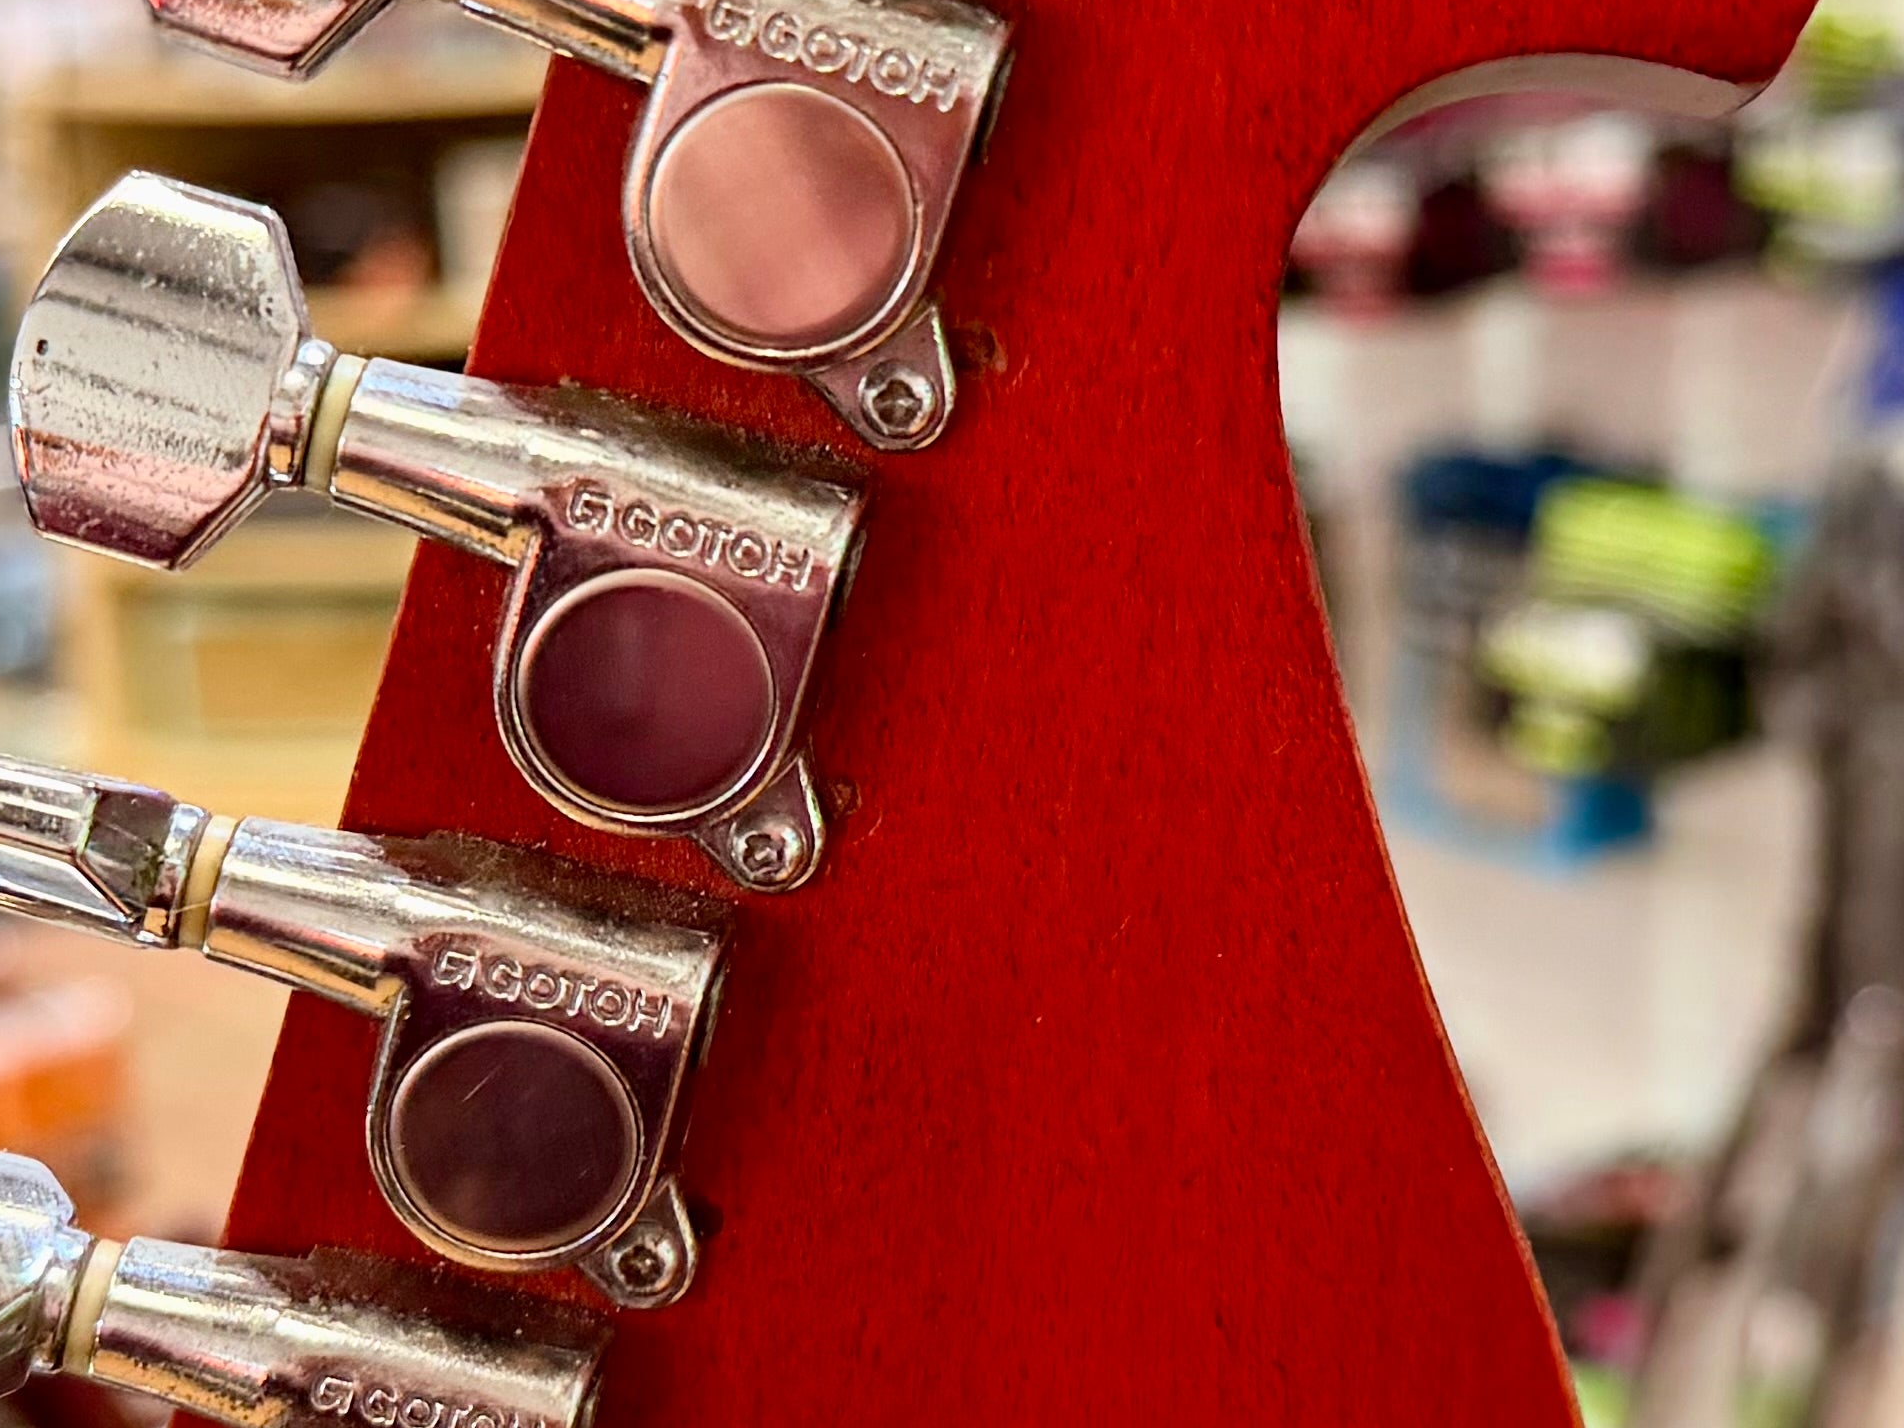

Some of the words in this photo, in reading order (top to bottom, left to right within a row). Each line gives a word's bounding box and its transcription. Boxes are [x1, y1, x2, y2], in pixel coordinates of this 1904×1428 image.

[759, 10, 960, 114] GOTOH
[619, 500, 814, 593] GOTOH
[484, 954, 673, 1039] GOTOH
